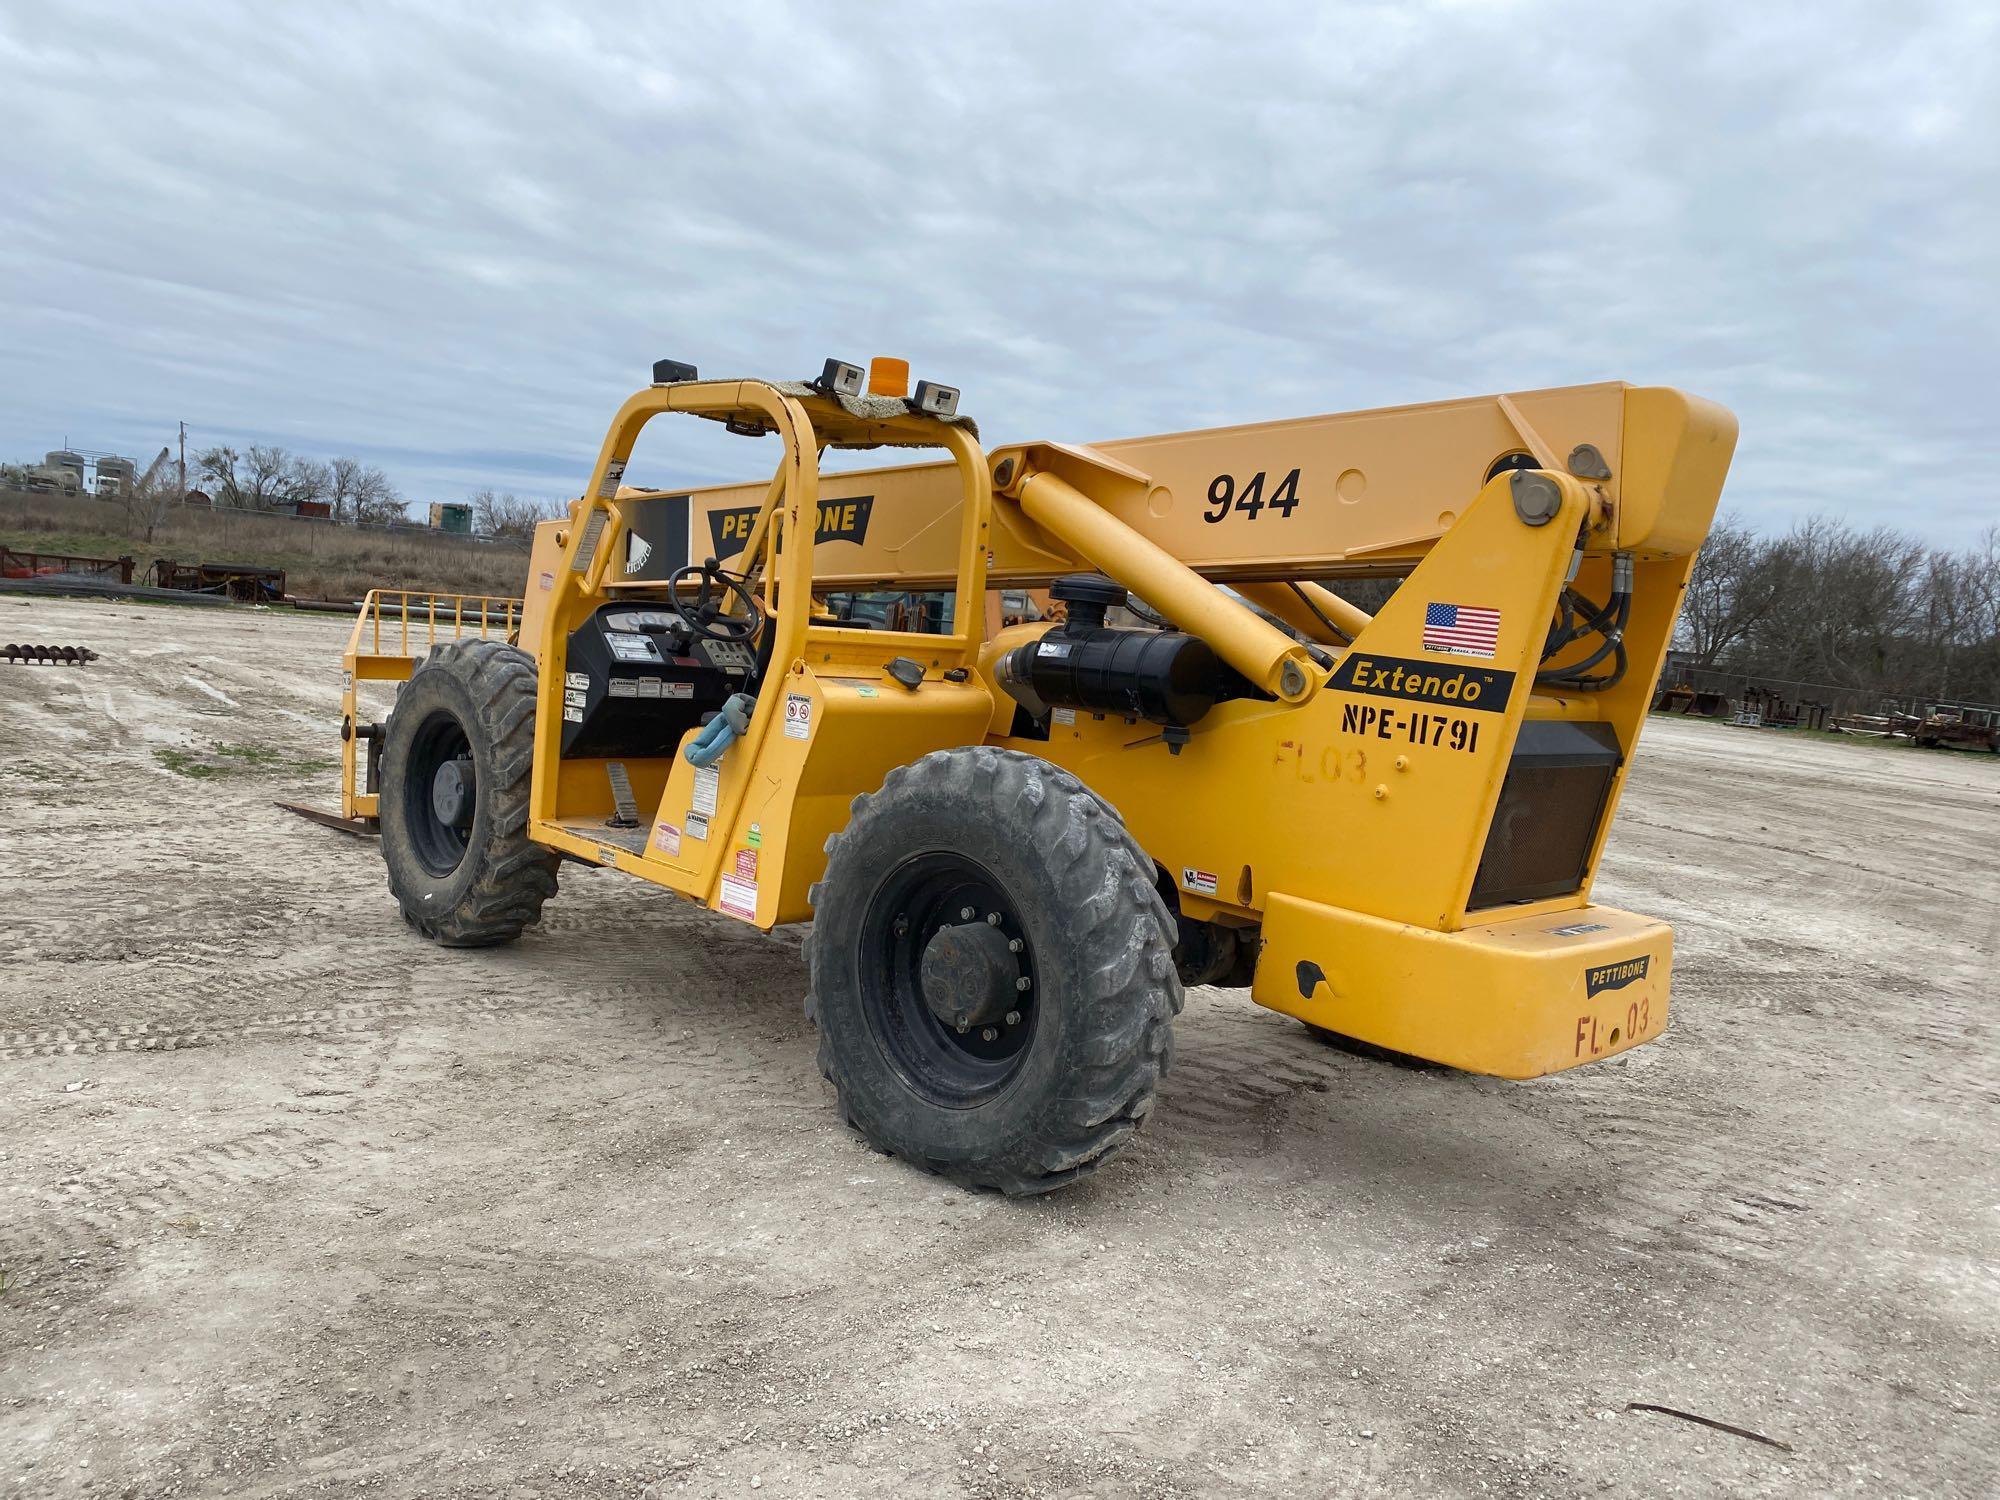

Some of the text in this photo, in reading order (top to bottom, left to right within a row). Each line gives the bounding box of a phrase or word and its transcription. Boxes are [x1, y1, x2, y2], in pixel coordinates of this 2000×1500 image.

[1203, 468, 1301, 524] 944
[721, 504, 857, 540] PEONE
[1342, 703, 1480, 753] NPE-11791
[1592, 960, 1645, 986] PETTIBONE
